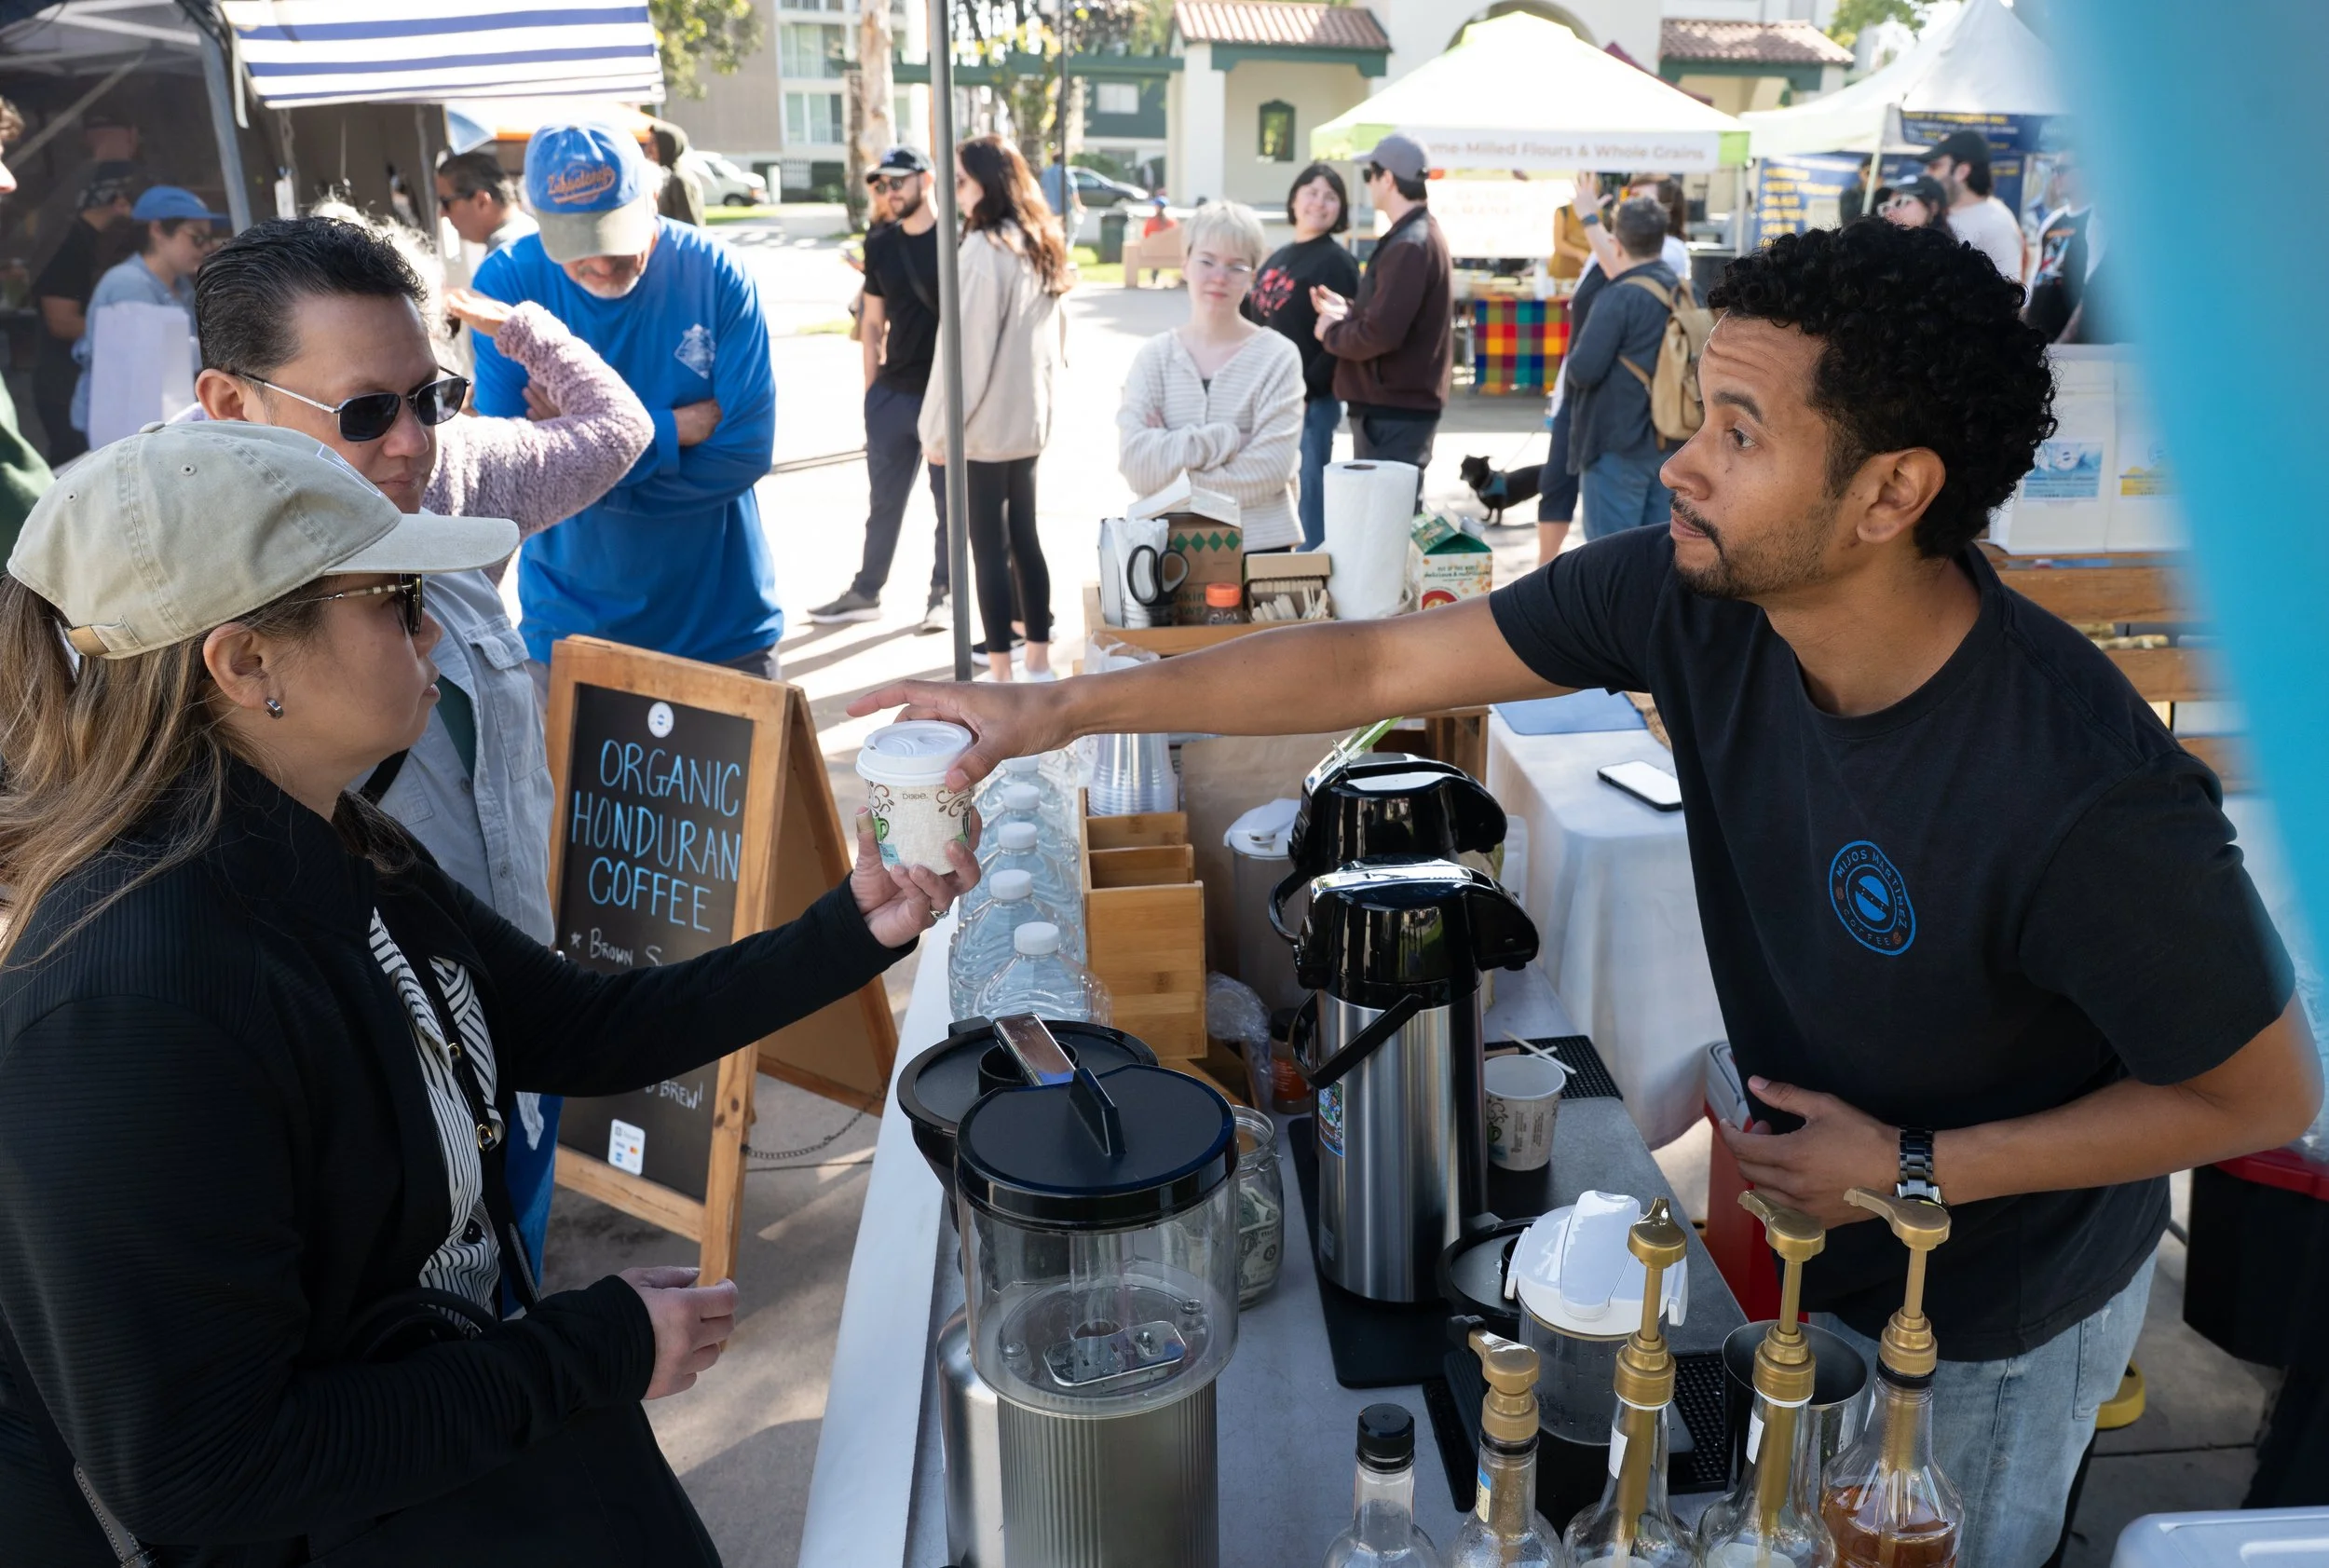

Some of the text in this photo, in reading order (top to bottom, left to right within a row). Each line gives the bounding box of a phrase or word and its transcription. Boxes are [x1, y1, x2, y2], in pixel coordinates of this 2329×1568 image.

[1522, 142, 1573, 157] Flours
[1578, 143, 1588, 157] &
[1594, 143, 1648, 158] Whole
[1652, 143, 1706, 160] Grains
[600, 739, 741, 817] ORGANIC
[571, 790, 742, 882] HONDURAN
[588, 856, 712, 933] COFFEE
[1835, 849, 1908, 929] MIJOS MARTINEZ
[1843, 908, 1892, 947] COFFEE
